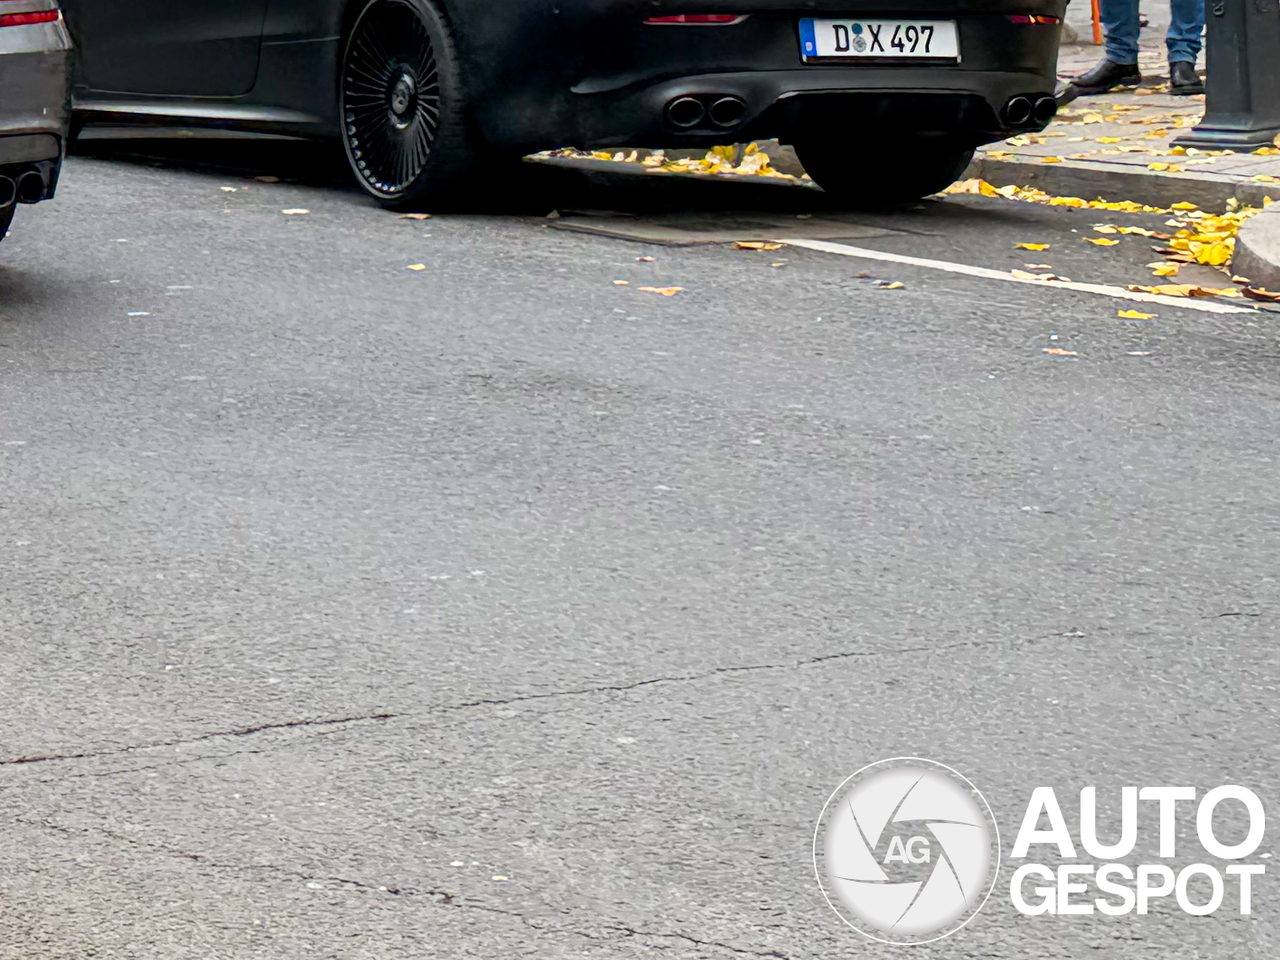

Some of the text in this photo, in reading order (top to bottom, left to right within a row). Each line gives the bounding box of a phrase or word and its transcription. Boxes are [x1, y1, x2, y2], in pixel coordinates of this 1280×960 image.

[832, 24, 935, 53] D X 497
